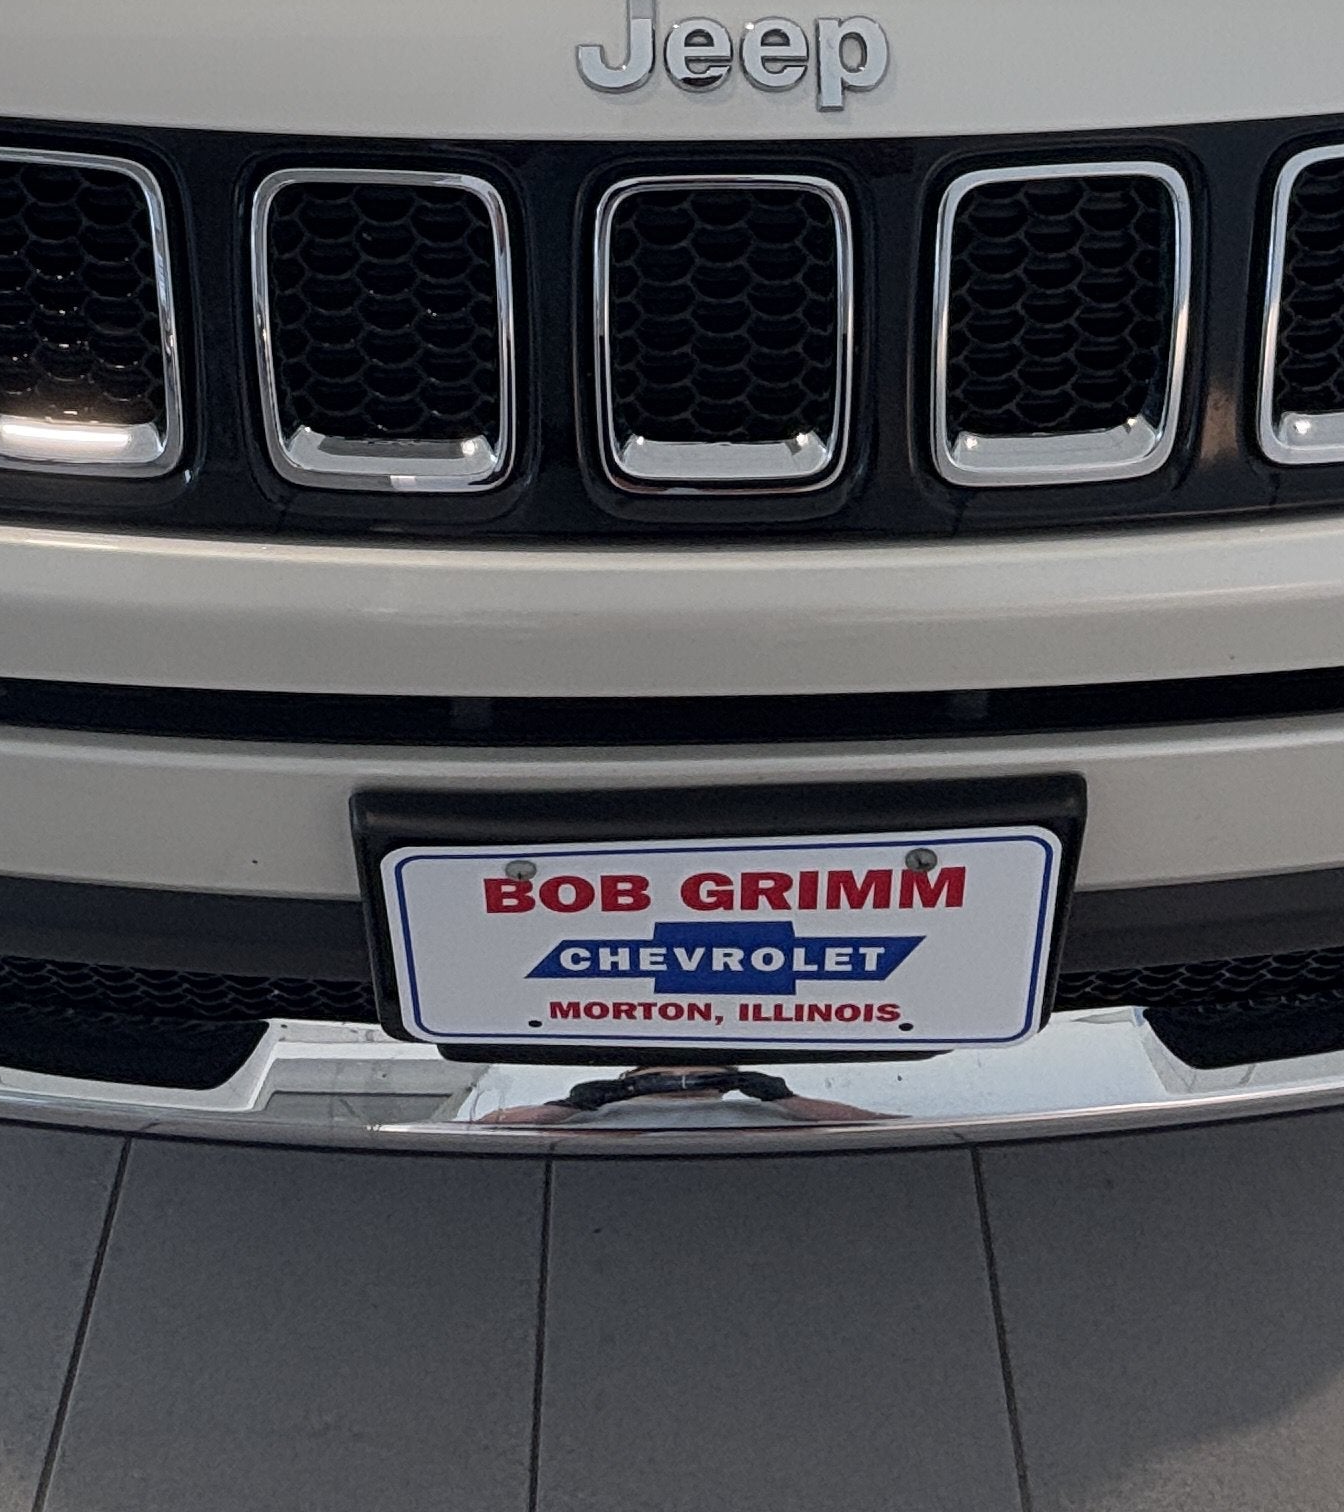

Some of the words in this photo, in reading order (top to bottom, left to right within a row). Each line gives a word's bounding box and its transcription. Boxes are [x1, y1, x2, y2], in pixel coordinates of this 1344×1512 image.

[483, 874, 652, 914] BOB
[680, 866, 966, 912] GRIMM
[559, 945, 886, 972] CHEVROLET
[549, 1000, 725, 1026] MORTON,
[738, 1002, 902, 1022] ILLINOIS
